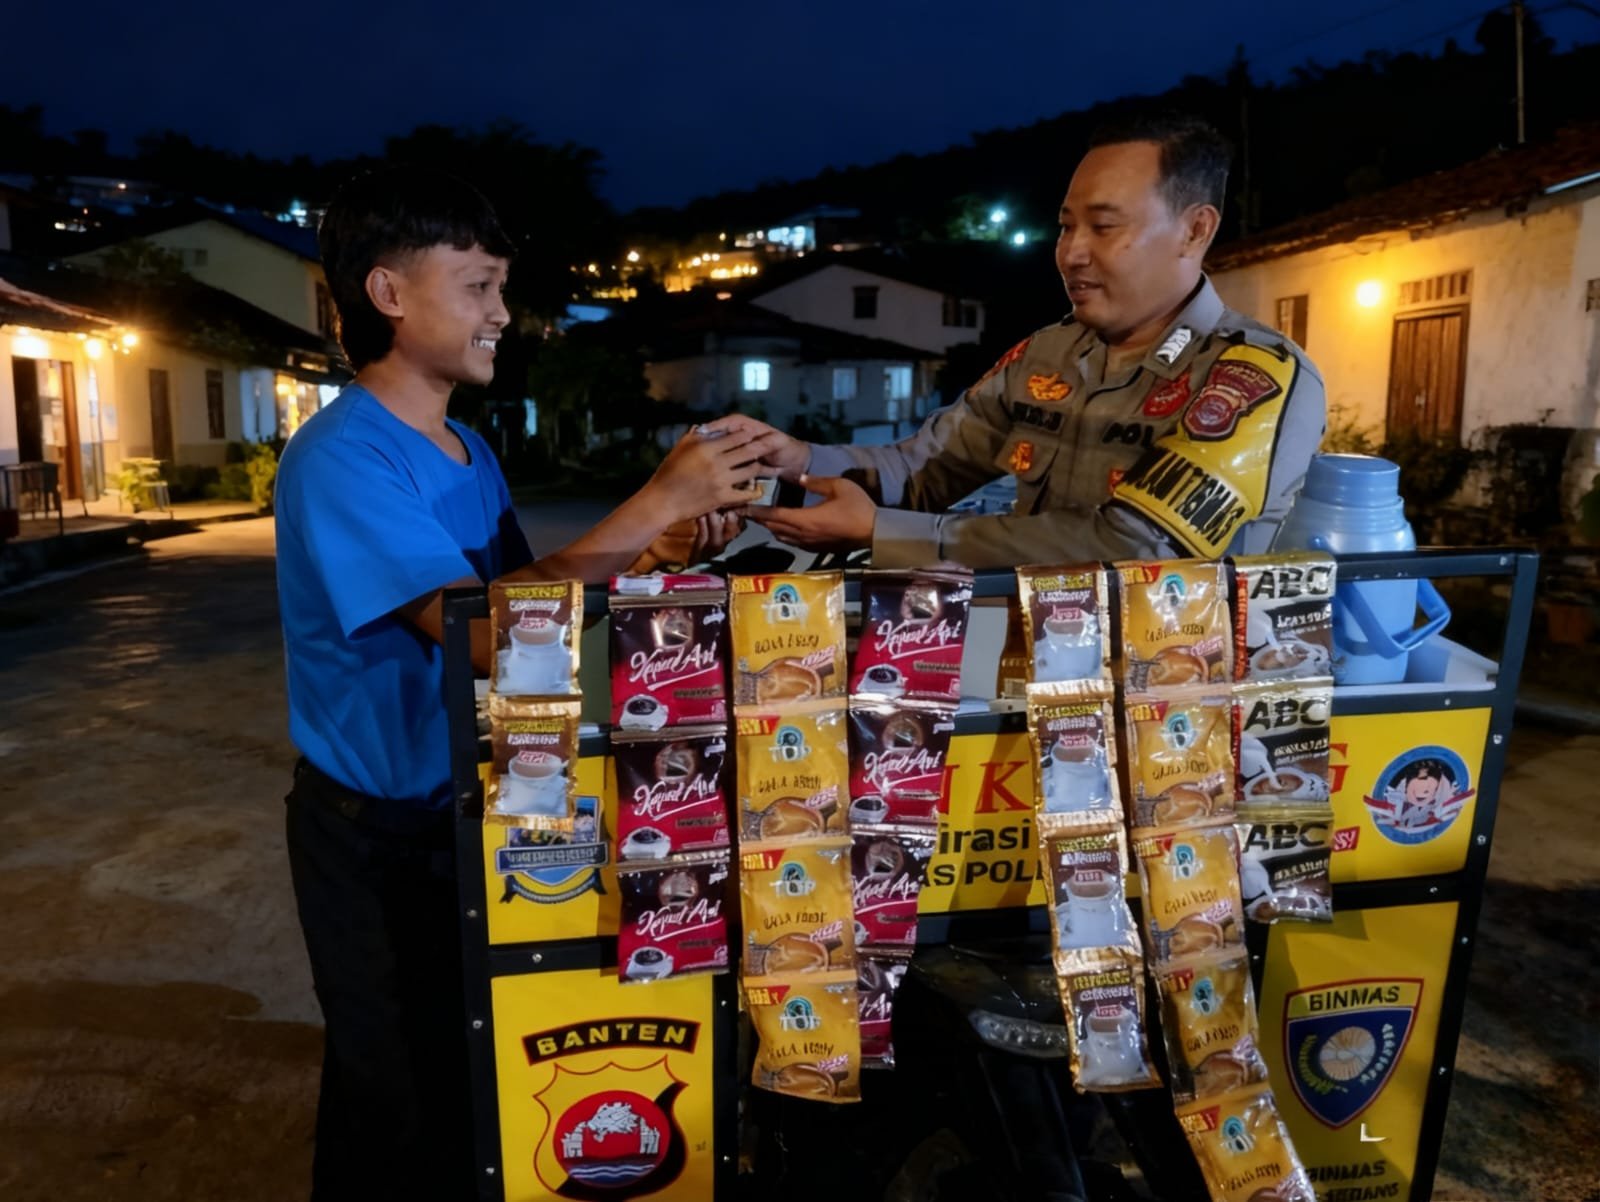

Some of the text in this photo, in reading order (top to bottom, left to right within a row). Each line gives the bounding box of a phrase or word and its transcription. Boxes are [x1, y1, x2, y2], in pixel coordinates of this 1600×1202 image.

[1250, 566, 1332, 599] ABC
[1243, 697, 1328, 732] ABC
[974, 760, 1034, 815] K
[1243, 823, 1328, 854] ABC
[1308, 985, 1401, 1012] BINMAS
[535, 1022, 688, 1056] BANTEN
